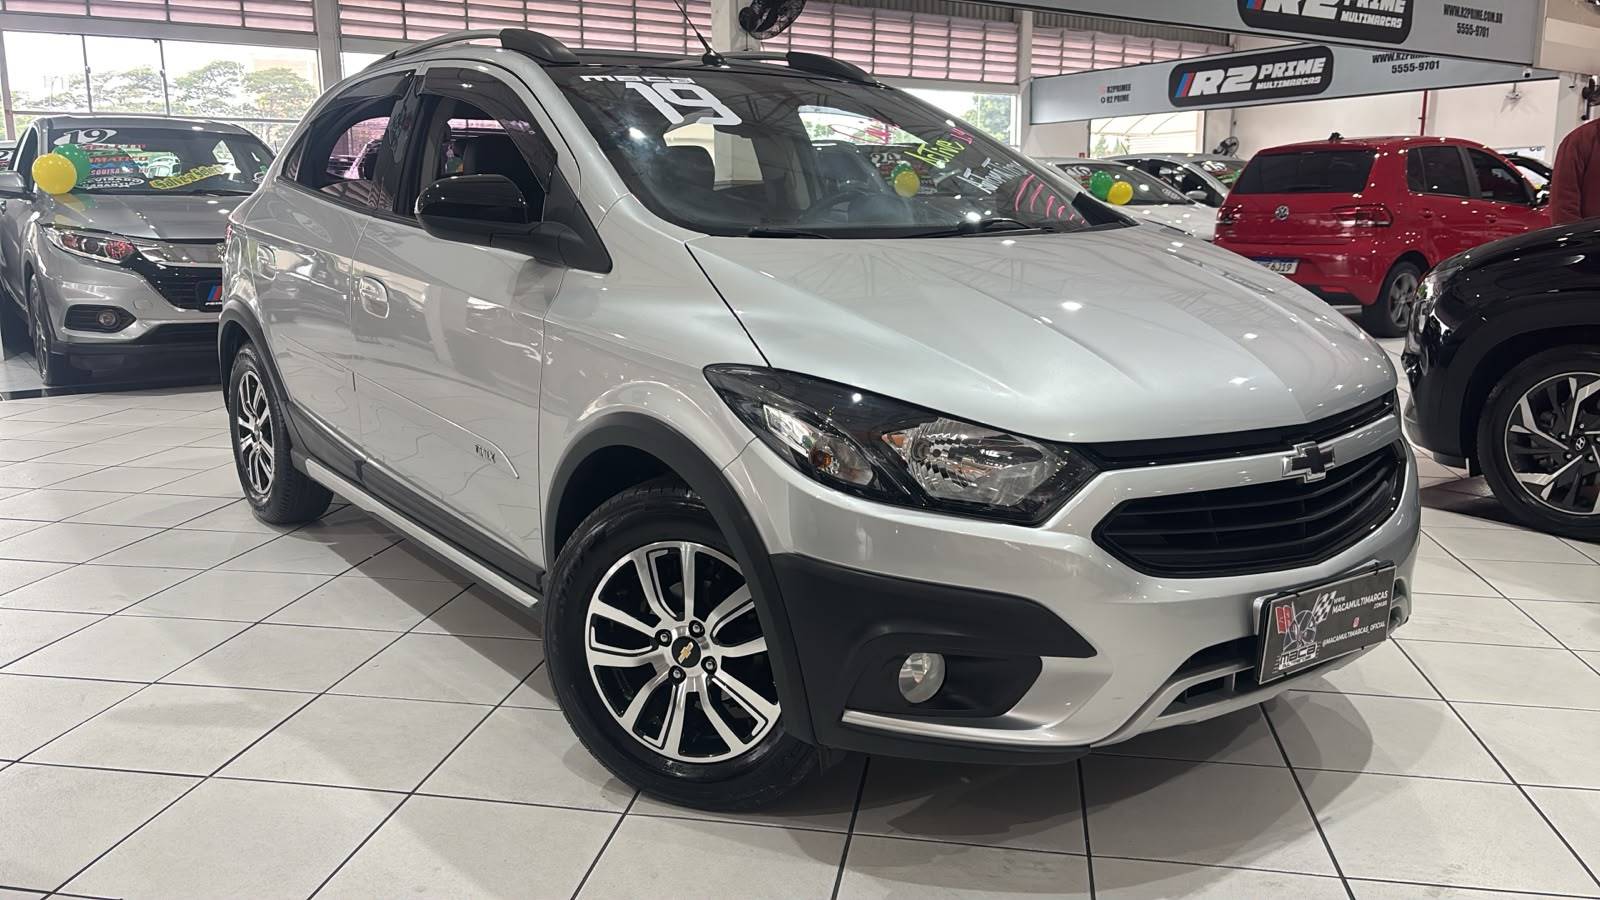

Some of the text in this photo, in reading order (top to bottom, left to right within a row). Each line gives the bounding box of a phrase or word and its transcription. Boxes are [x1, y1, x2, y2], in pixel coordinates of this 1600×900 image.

[1340, 11, 1403, 29] MULTIMARCAS
[1456, 22, 1490, 38] 5555-9701
[1392, 60, 1440, 74] 5555-9701
[1188, 57, 1327, 97] R2 PRIME
[1255, 76, 1321, 90] MULTIMARCAS
[626, 81, 743, 126] 19
[64, 128, 109, 144] 19
[1331, 590, 1388, 615] MACAMULTIMARCAS
